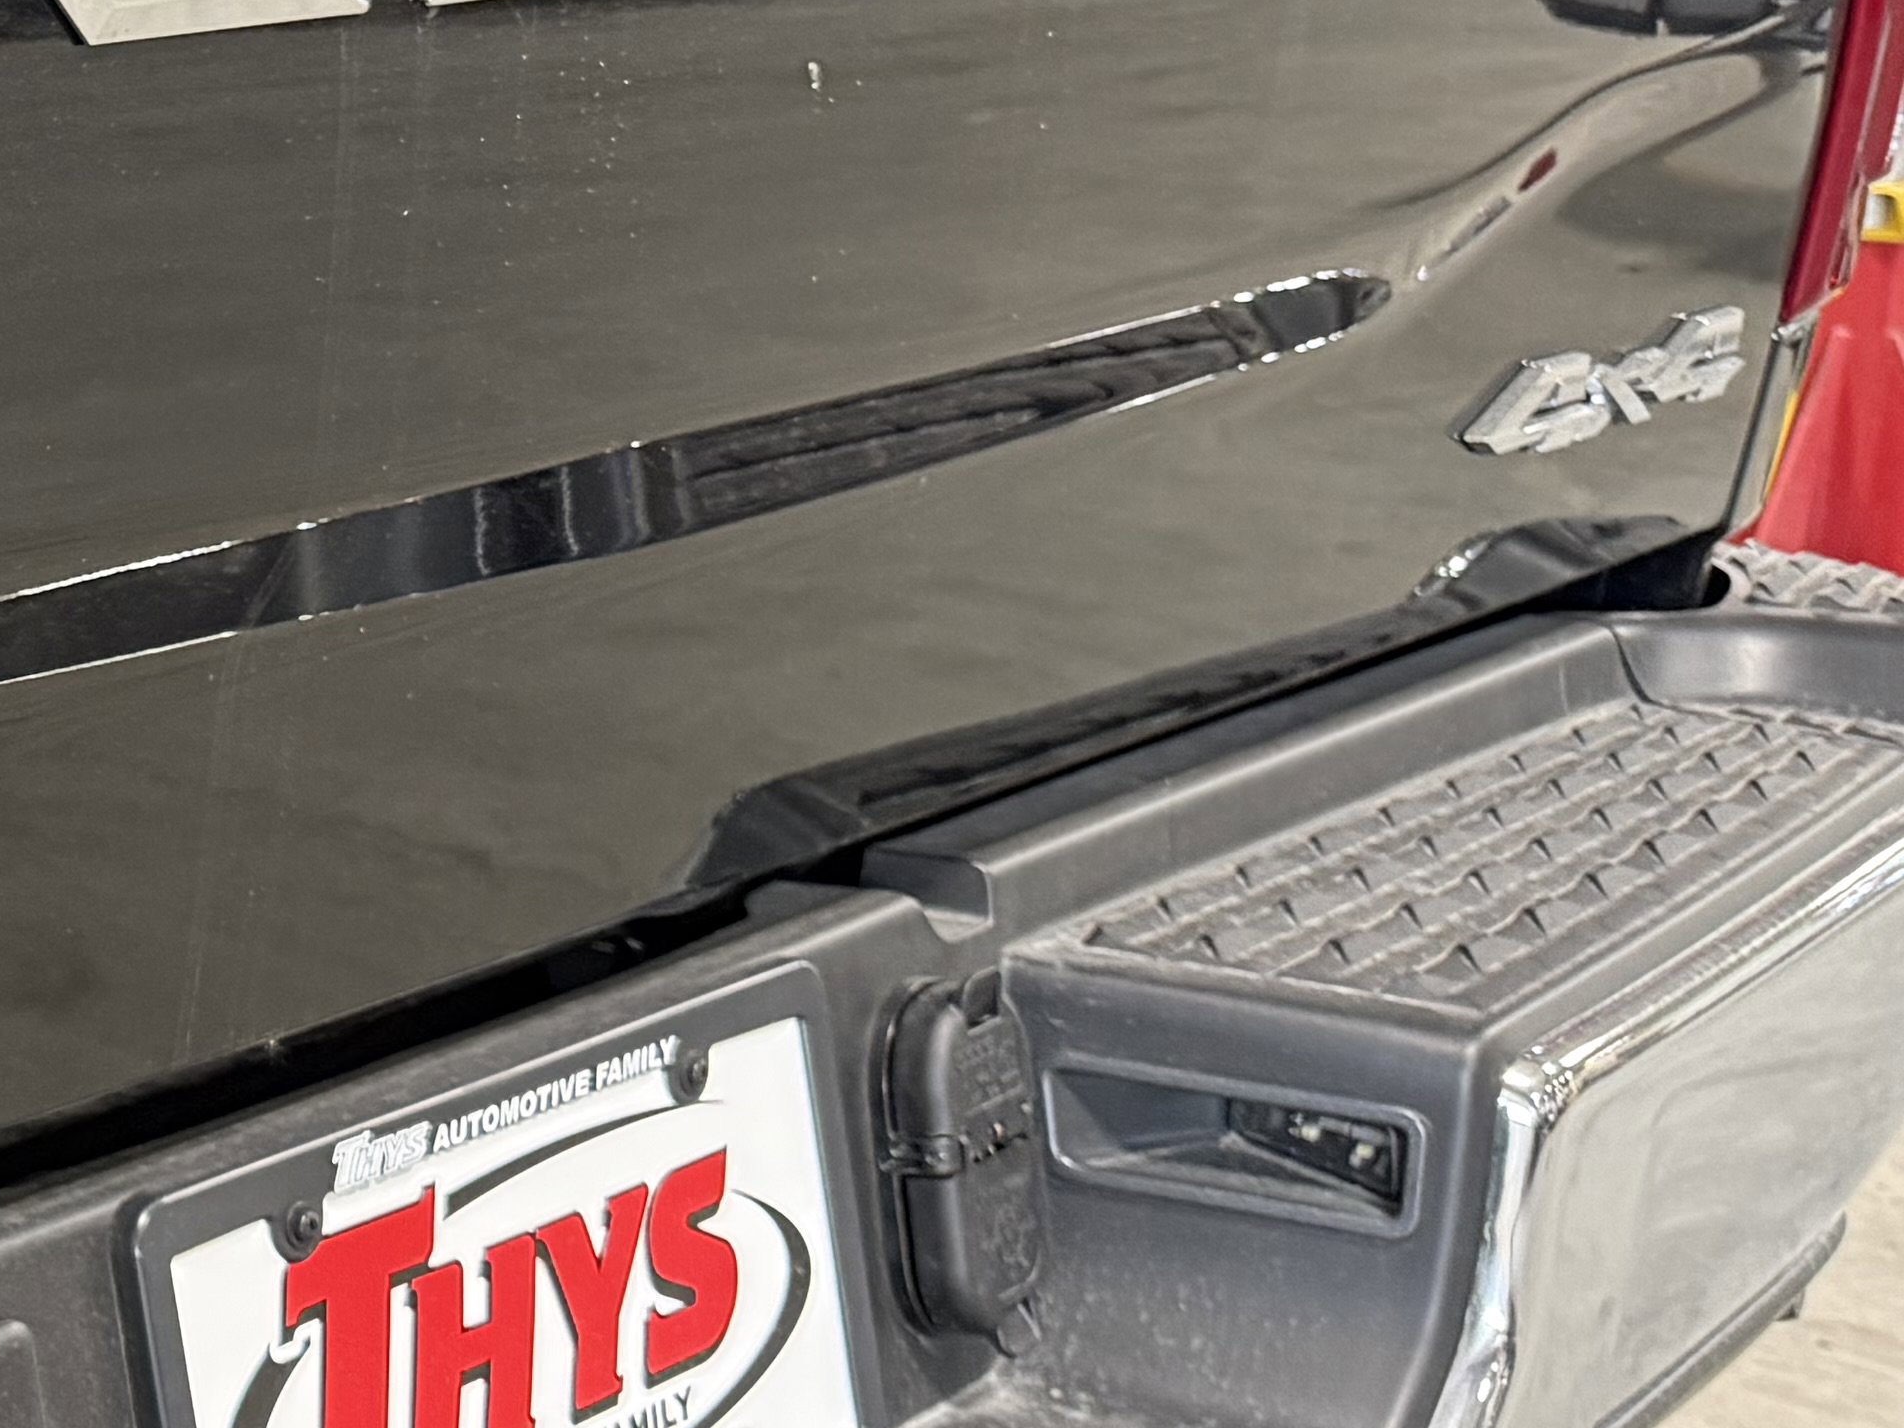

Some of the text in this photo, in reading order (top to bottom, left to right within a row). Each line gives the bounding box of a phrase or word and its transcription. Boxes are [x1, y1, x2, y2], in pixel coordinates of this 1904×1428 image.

[331, 1034, 678, 1194] THYS AUTOMOTIVE FAMILY
